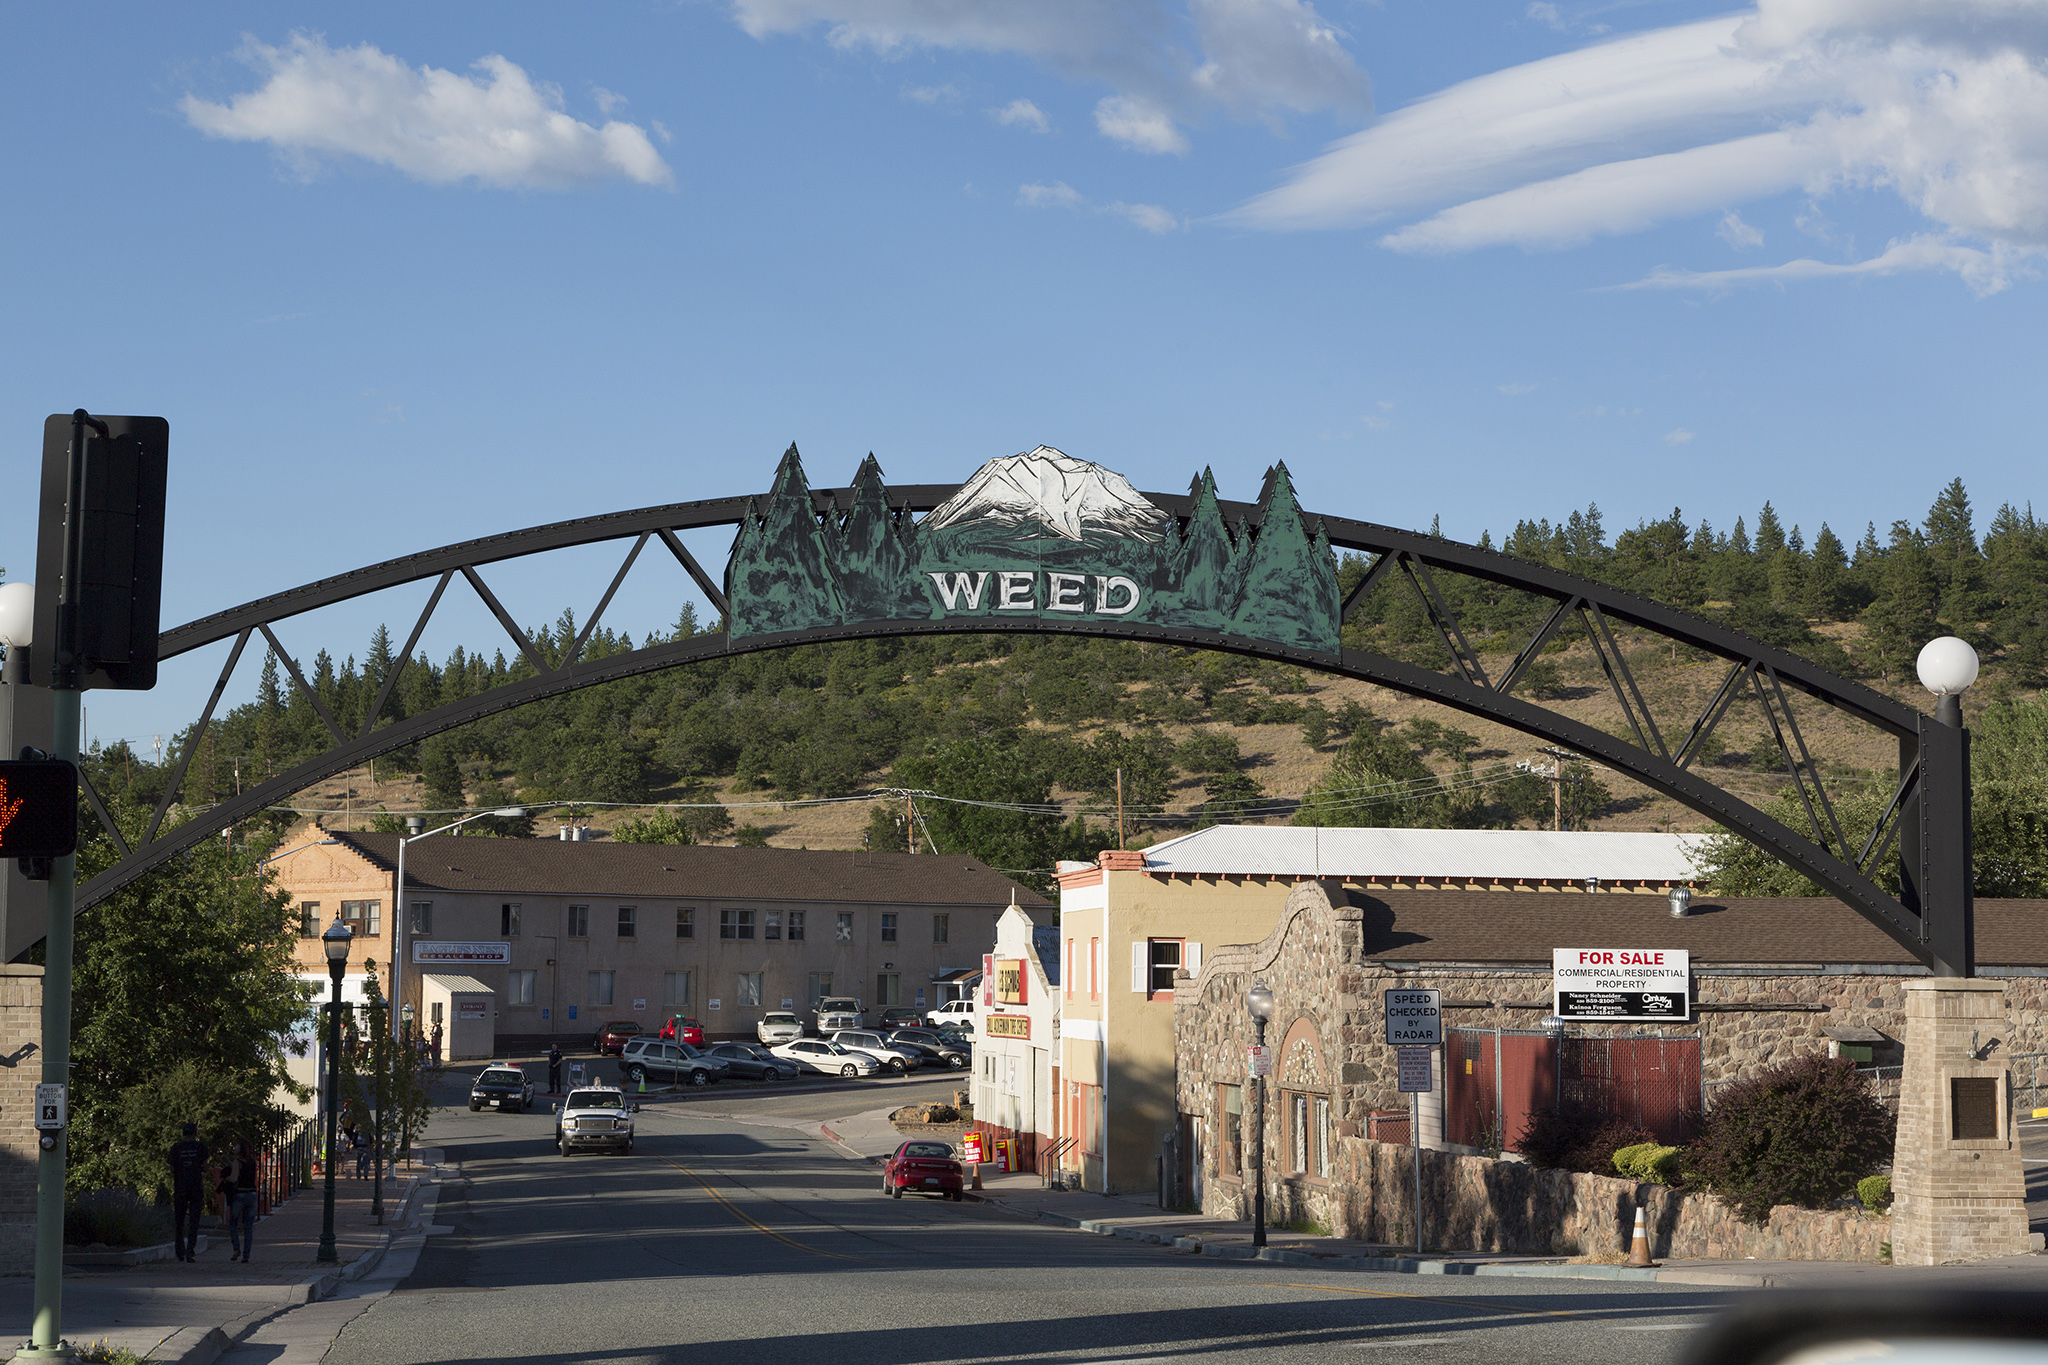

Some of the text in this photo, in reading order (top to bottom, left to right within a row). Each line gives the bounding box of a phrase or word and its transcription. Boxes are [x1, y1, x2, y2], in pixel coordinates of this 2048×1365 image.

[927, 571, 1141, 615] WEED
[473, 945, 505, 954] NEST
[1579, 952, 1664, 965] FOR SALE
[1558, 968, 1685, 977] COMMERCIAL/RESIDENTIAL
[1596, 980, 1647, 988] PROPERTY
[1394, 995, 1431, 1003] SPEED
[1664, 999, 1673, 1008] 21
[1389, 1008, 1437, 1016] CHECKED
[1394, 1031, 1433, 1039] RADAR
